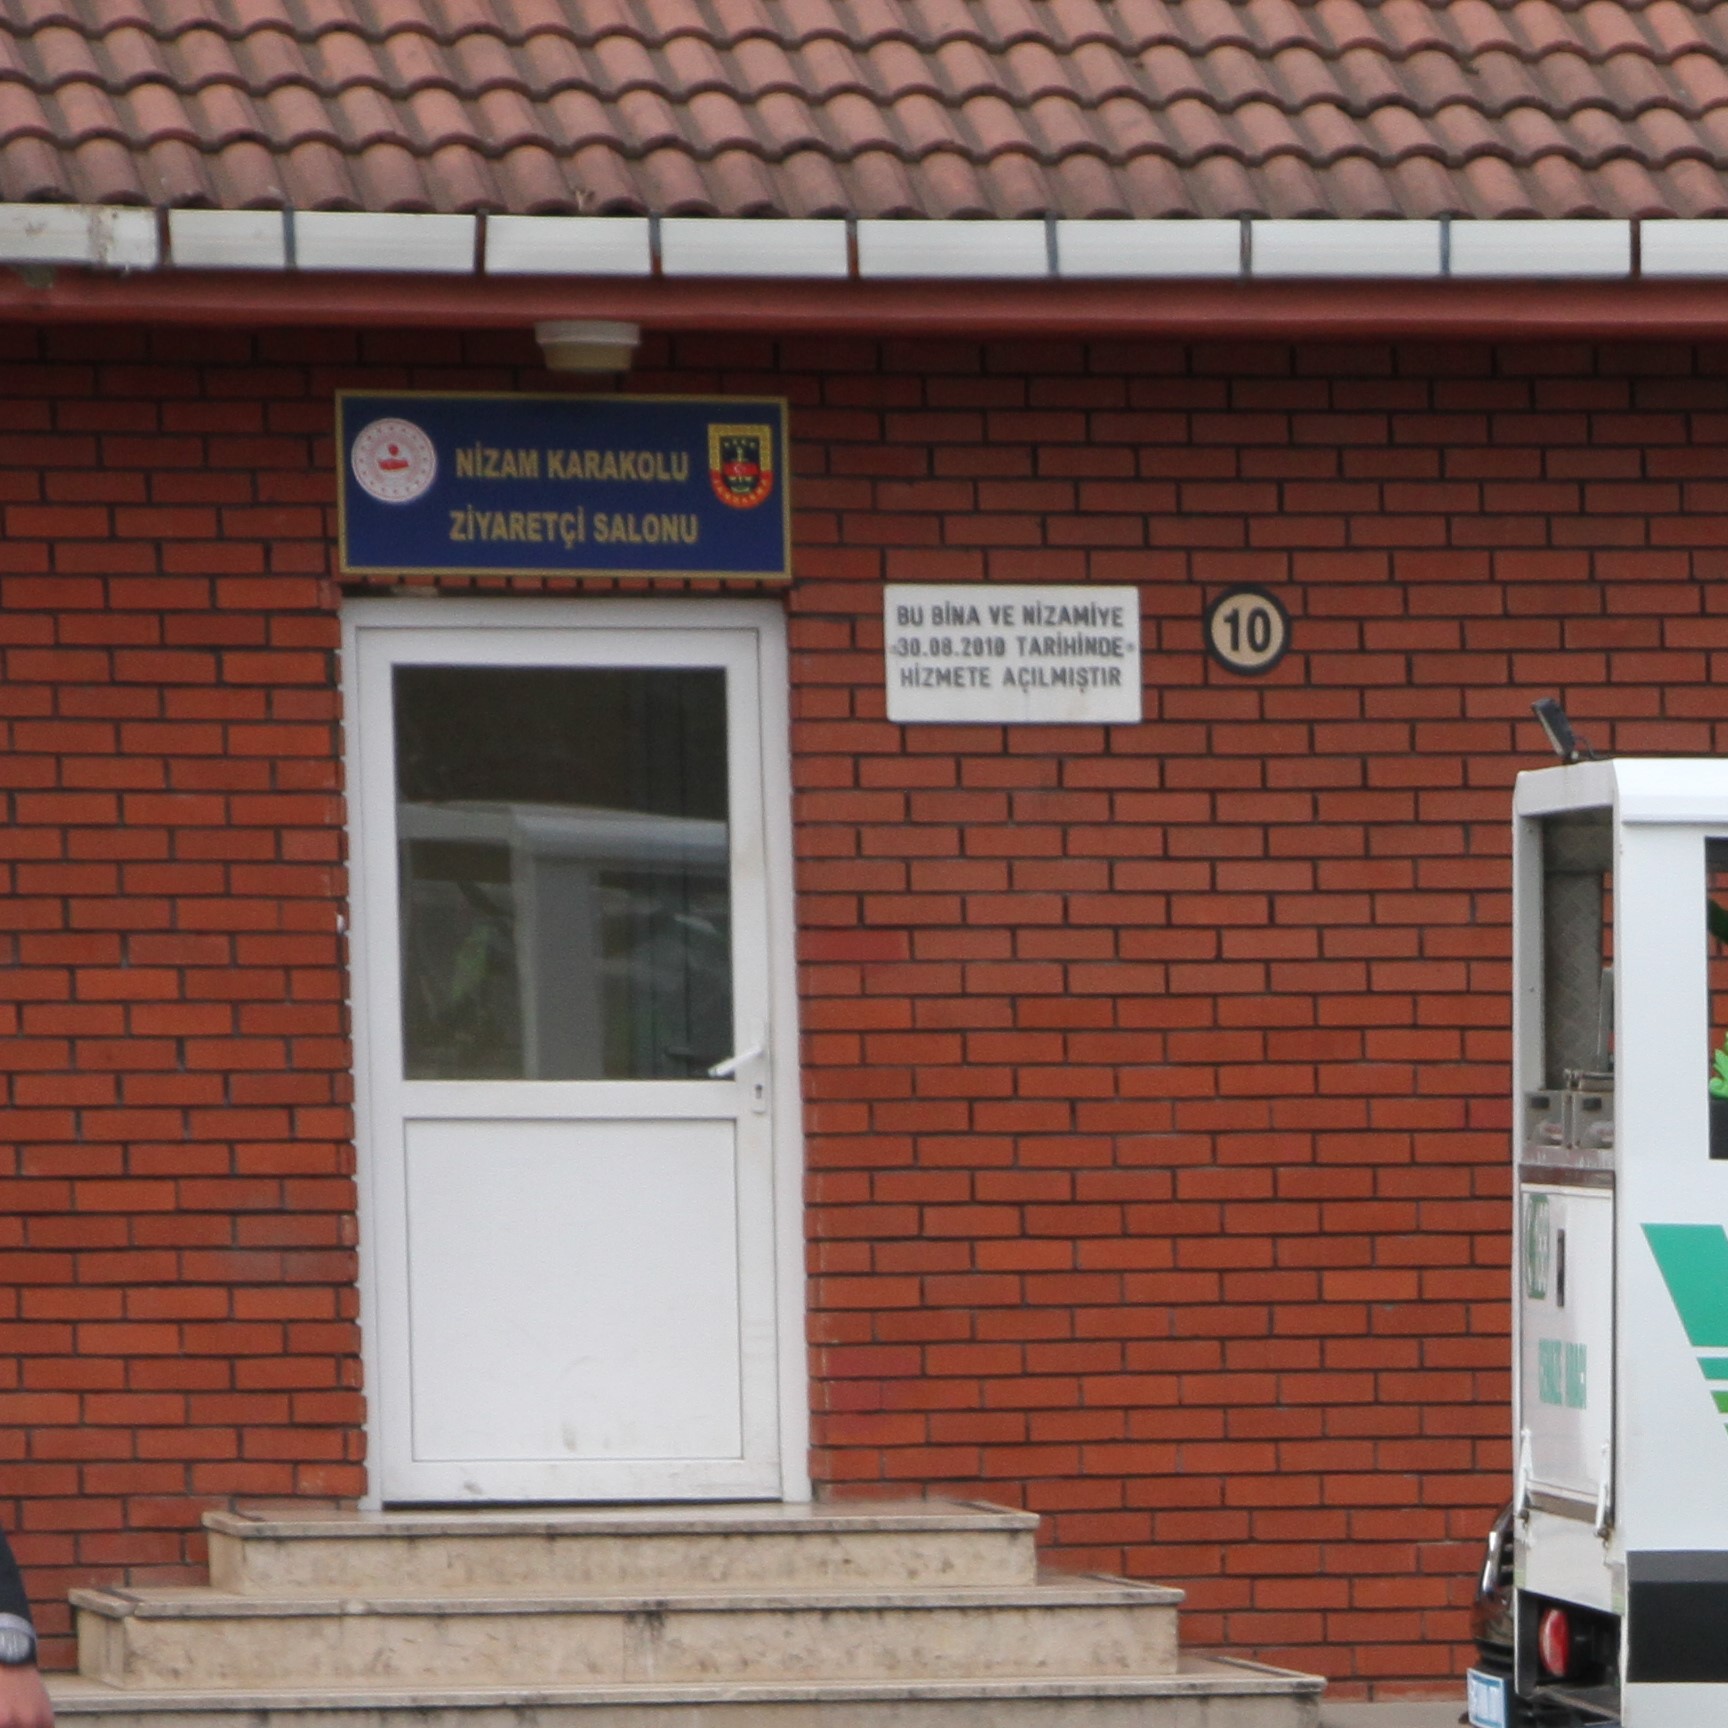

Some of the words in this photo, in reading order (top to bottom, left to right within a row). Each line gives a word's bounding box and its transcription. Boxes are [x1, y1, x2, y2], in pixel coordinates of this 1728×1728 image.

[455, 441, 540, 480] NİZAM
[547, 450, 690, 482] KARAKOLU
[449, 504, 587, 550] ZİYARETÇİ
[593, 512, 699, 544] SALONU
[896, 605, 924, 627] BU
[931, 601, 981, 626] BİNA
[989, 604, 1015, 626] VE
[1022, 601, 1124, 628] NİZAMİYE
[1222, 606, 1273, 653] 10
[897, 636, 1006, 658] 30.08.2010
[1015, 631, 1125, 658] TARİHİNDE
[900, 662, 992, 688] HİZMETE
[1002, 666, 1122, 694] AÇILMIŞTIR
